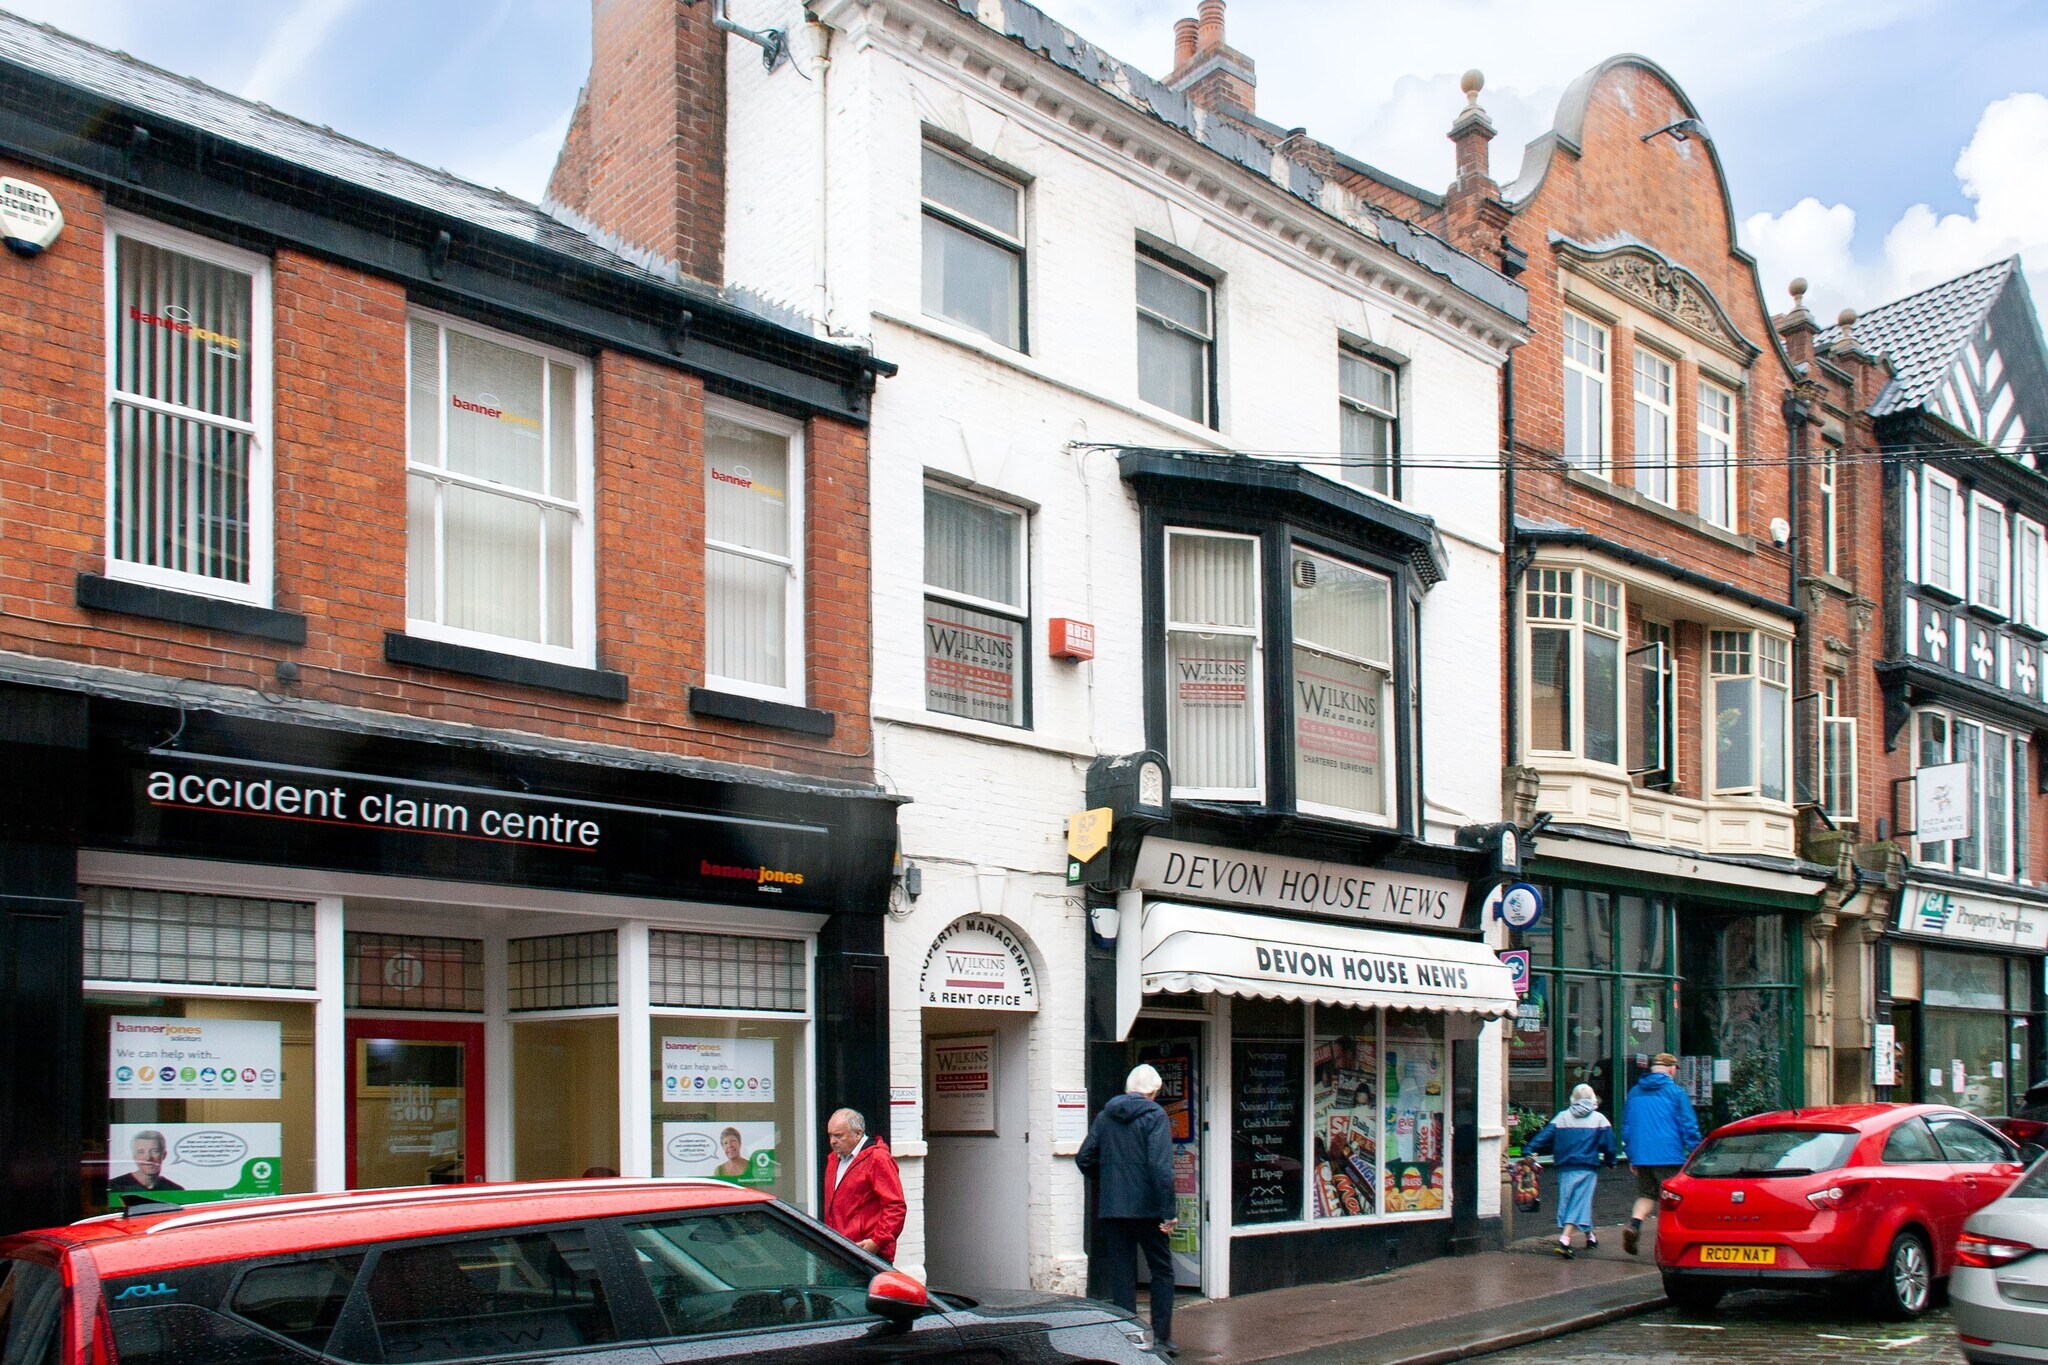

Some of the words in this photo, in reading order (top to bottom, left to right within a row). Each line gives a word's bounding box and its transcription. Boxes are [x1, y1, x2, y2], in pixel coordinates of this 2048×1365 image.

[4, 184, 47, 204] DIRECT
[0, 195, 55, 220] SECURITY
[927, 624, 1013, 659] WILKINS
[1067, 623, 1092, 642] ABEL
[954, 649, 1012, 670] Hammond
[1178, 663, 1246, 680] WILKINS
[930, 690, 967, 703] CHARTERED
[973, 698, 1009, 711] SURVEYORS
[1297, 680, 1376, 716] WILKINS
[1323, 708, 1376, 728] Hammond
[1303, 755, 1338, 768] CHARTERED
[1340, 761, 1373, 775] SURVEYORS
[147, 771, 347, 820] accident
[360, 793, 468, 832] claim
[480, 810, 600, 846] centre
[701, 860, 805, 885] bannerjones
[1163, 853, 1268, 897] DEVON
[1279, 869, 1375, 911] HOUSE
[1383, 884, 1449, 920] NEWS
[1956, 905, 1997, 932] Property
[1998, 911, 2034, 934] Services
[946, 956, 1005, 974] WILKINS
[966, 920, 1033, 997] MANAGEMENT
[1255, 946, 1334, 978] DEVON
[1342, 956, 1409, 985] HOUSE
[1416, 964, 1468, 990] NEWS
[929, 992, 937, 1002] &
[942, 992, 973, 1004] RENT
[978, 994, 1020, 1006] OFFICE
[116, 1022, 202, 1036] bannerjones
[116, 1049, 135, 1058] We
[138, 1050, 158, 1059] can
[161, 1050, 185, 1060] help
[665, 1041, 721, 1052] bannerjones
[694, 1063, 711, 1072] help
[936, 1051, 989, 1071] WILKINS
[1057, 1093, 1086, 1103] WILKINS
[1240, 1100, 1269, 1111] National
[1270, 1100, 1294, 1112] Lottery
[1243, 1118, 1261, 1129] Cash
[1262, 1117, 1291, 1128] Machine
[1252, 1135, 1264, 1147] Pay
[1265, 1134, 1283, 1144] Point
[1255, 1152, 1279, 1163] Stamps
[1252, 1169, 1258, 1179] E
[1258, 1169, 1283, 1181] Top-up
[1706, 1247, 1740, 1261] RC07
[1743, 1248, 1770, 1262] NAT
